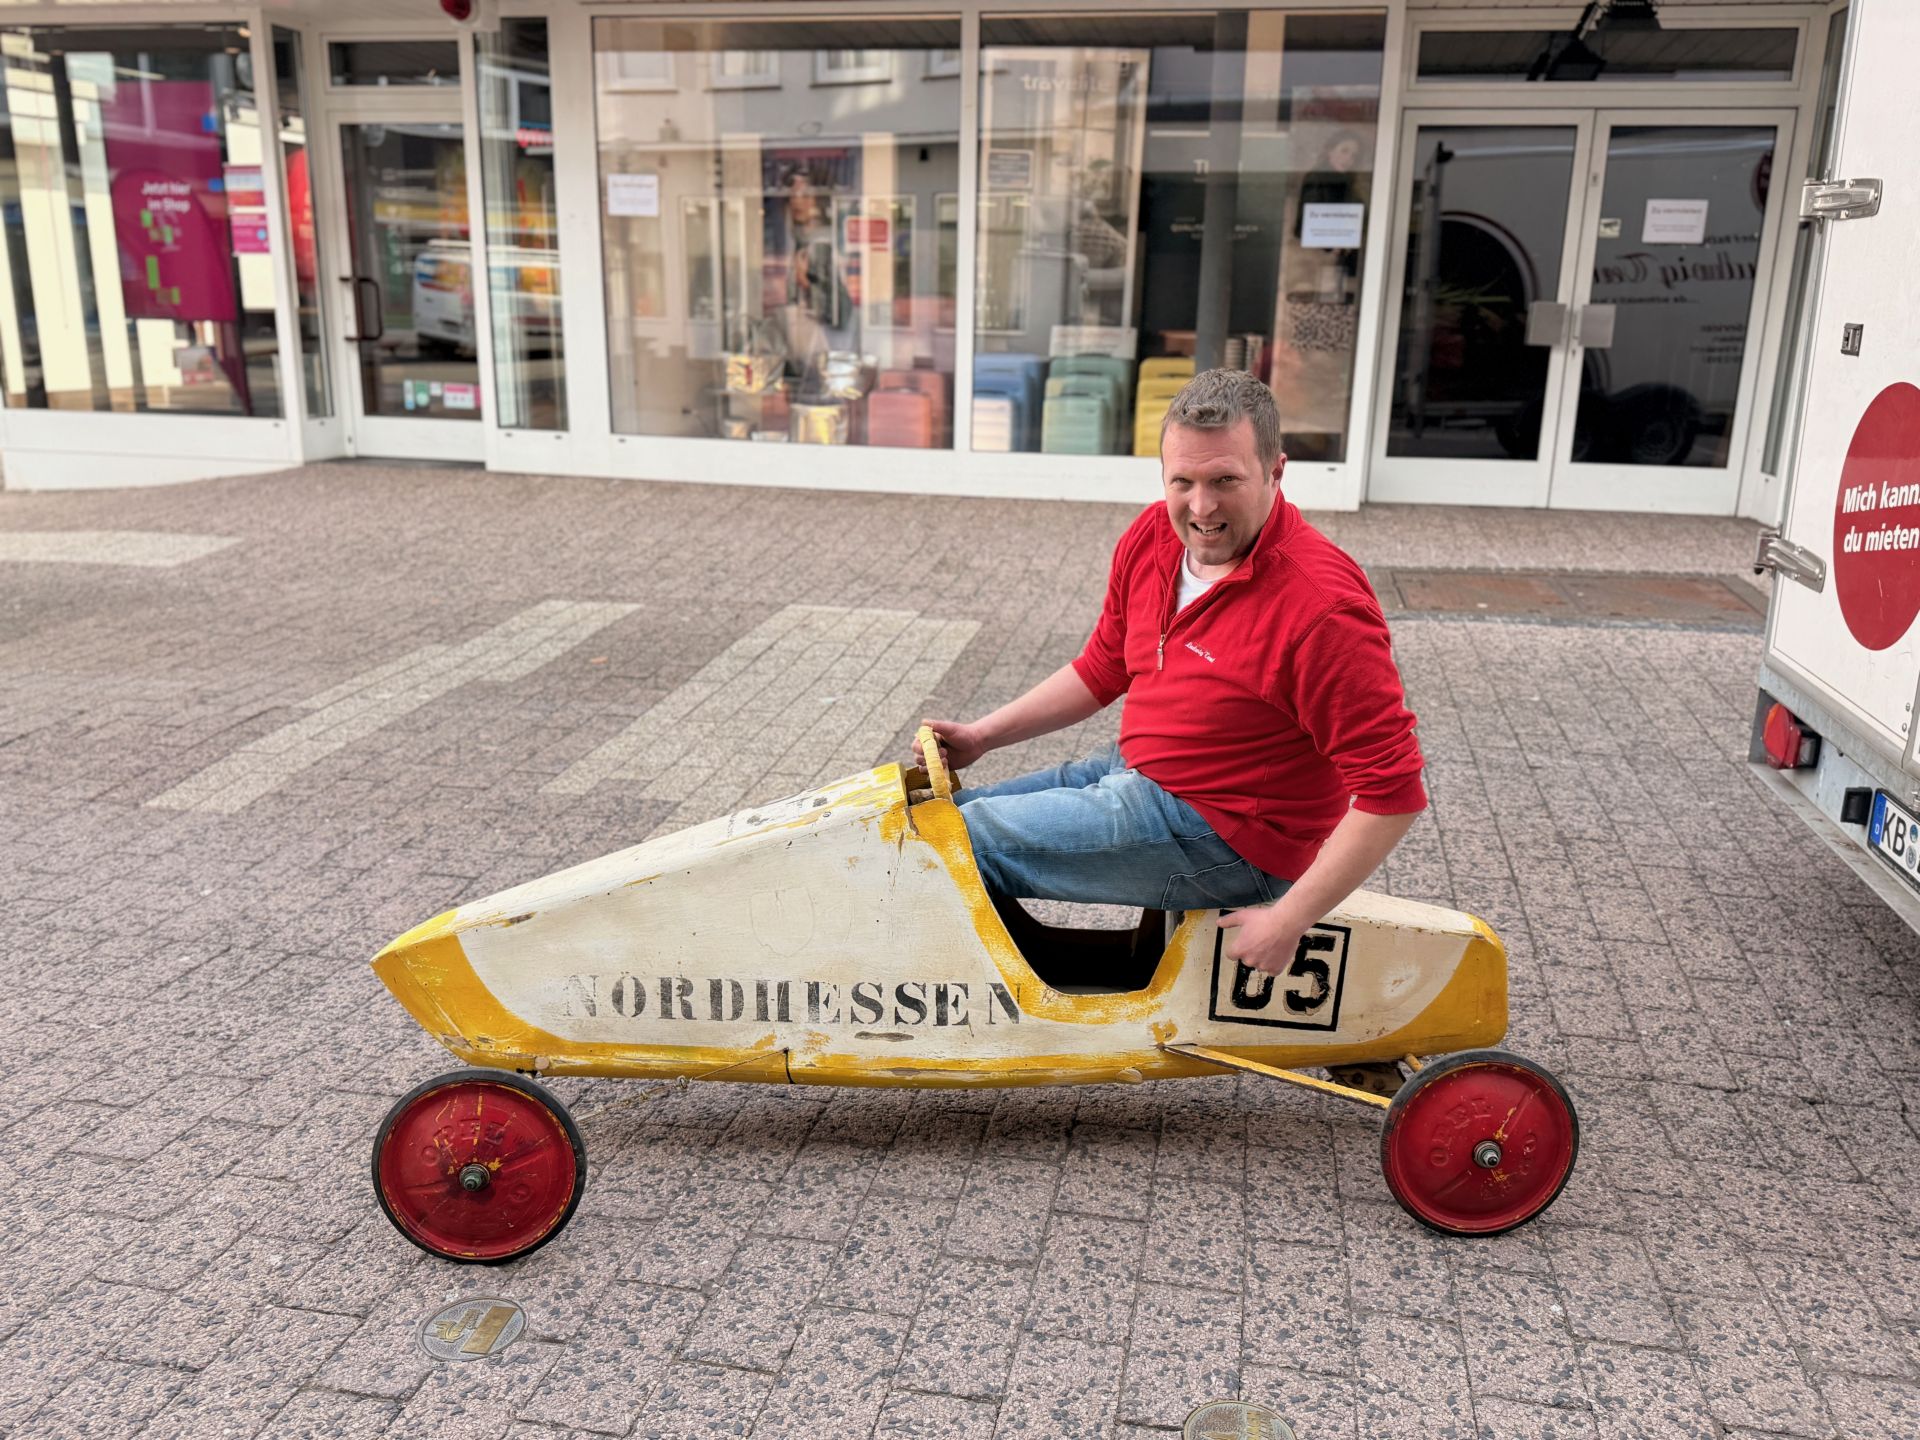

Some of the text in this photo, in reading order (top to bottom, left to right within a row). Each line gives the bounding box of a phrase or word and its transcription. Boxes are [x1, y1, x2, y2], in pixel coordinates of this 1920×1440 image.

[141, 181, 191, 196] Jetzt hier
[147, 198, 191, 213] im Shop
[1842, 480, 1920, 513] Mich kann
[1843, 522, 1920, 553] du mieten
[1881, 807, 1907, 857] KB
[562, 971, 1022, 1027] NORDHESSEN
